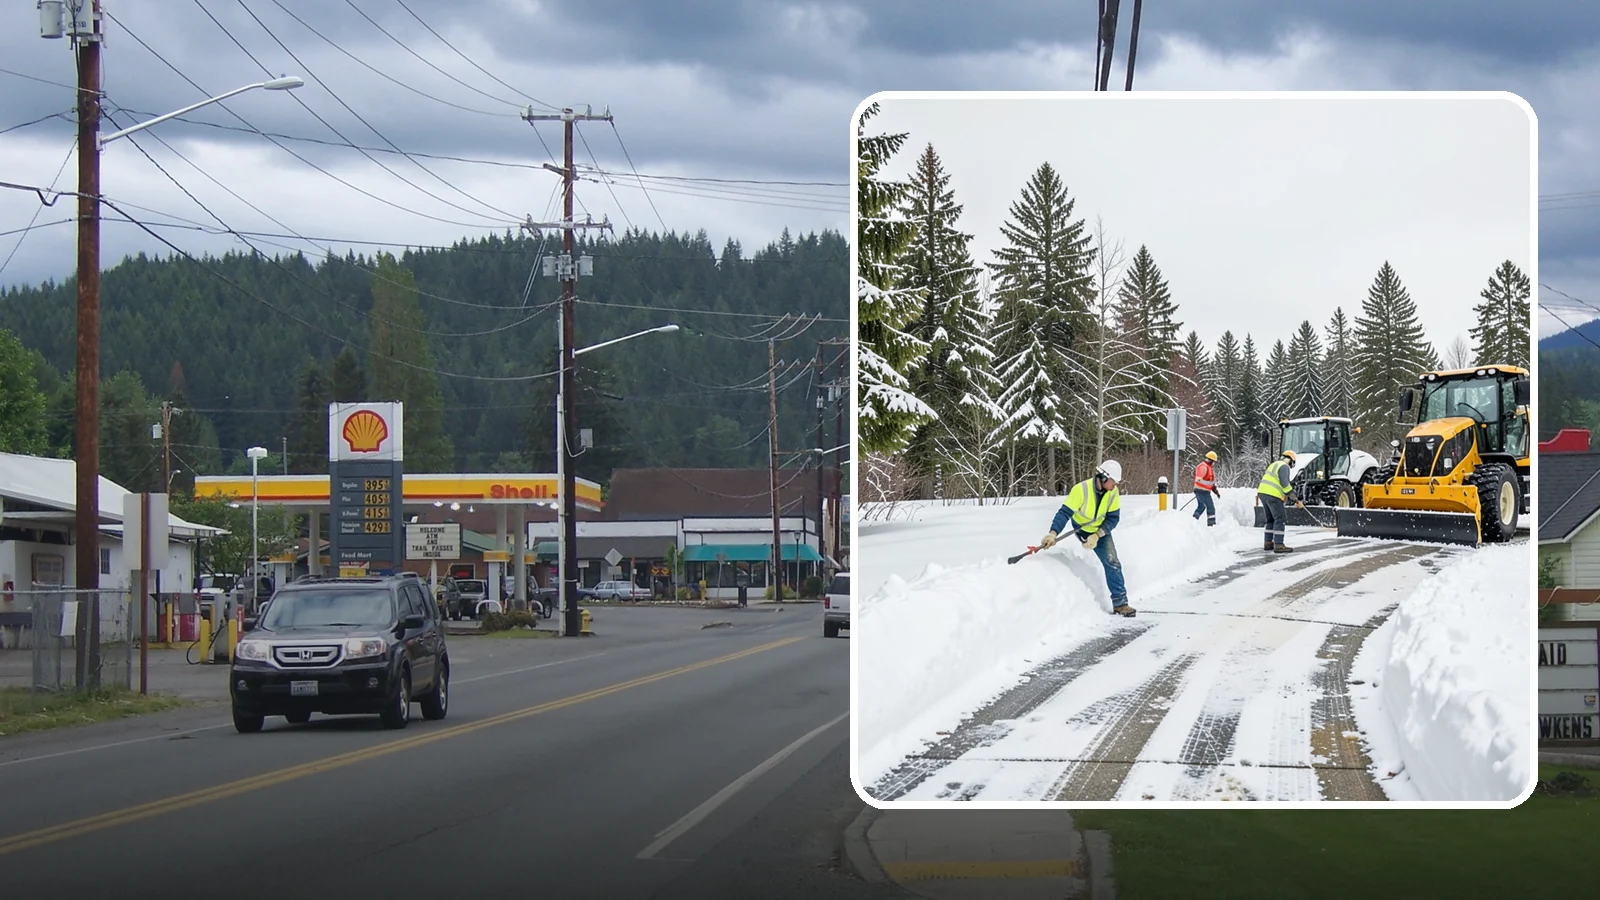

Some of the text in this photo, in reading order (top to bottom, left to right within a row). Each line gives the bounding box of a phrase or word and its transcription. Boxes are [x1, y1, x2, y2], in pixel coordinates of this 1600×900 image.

[366, 480, 384, 490] 395
[490, 484, 547, 499] Shell
[366, 494, 384, 504] 405
[366, 508, 383, 518] 415
[365, 522, 384, 532] 429
